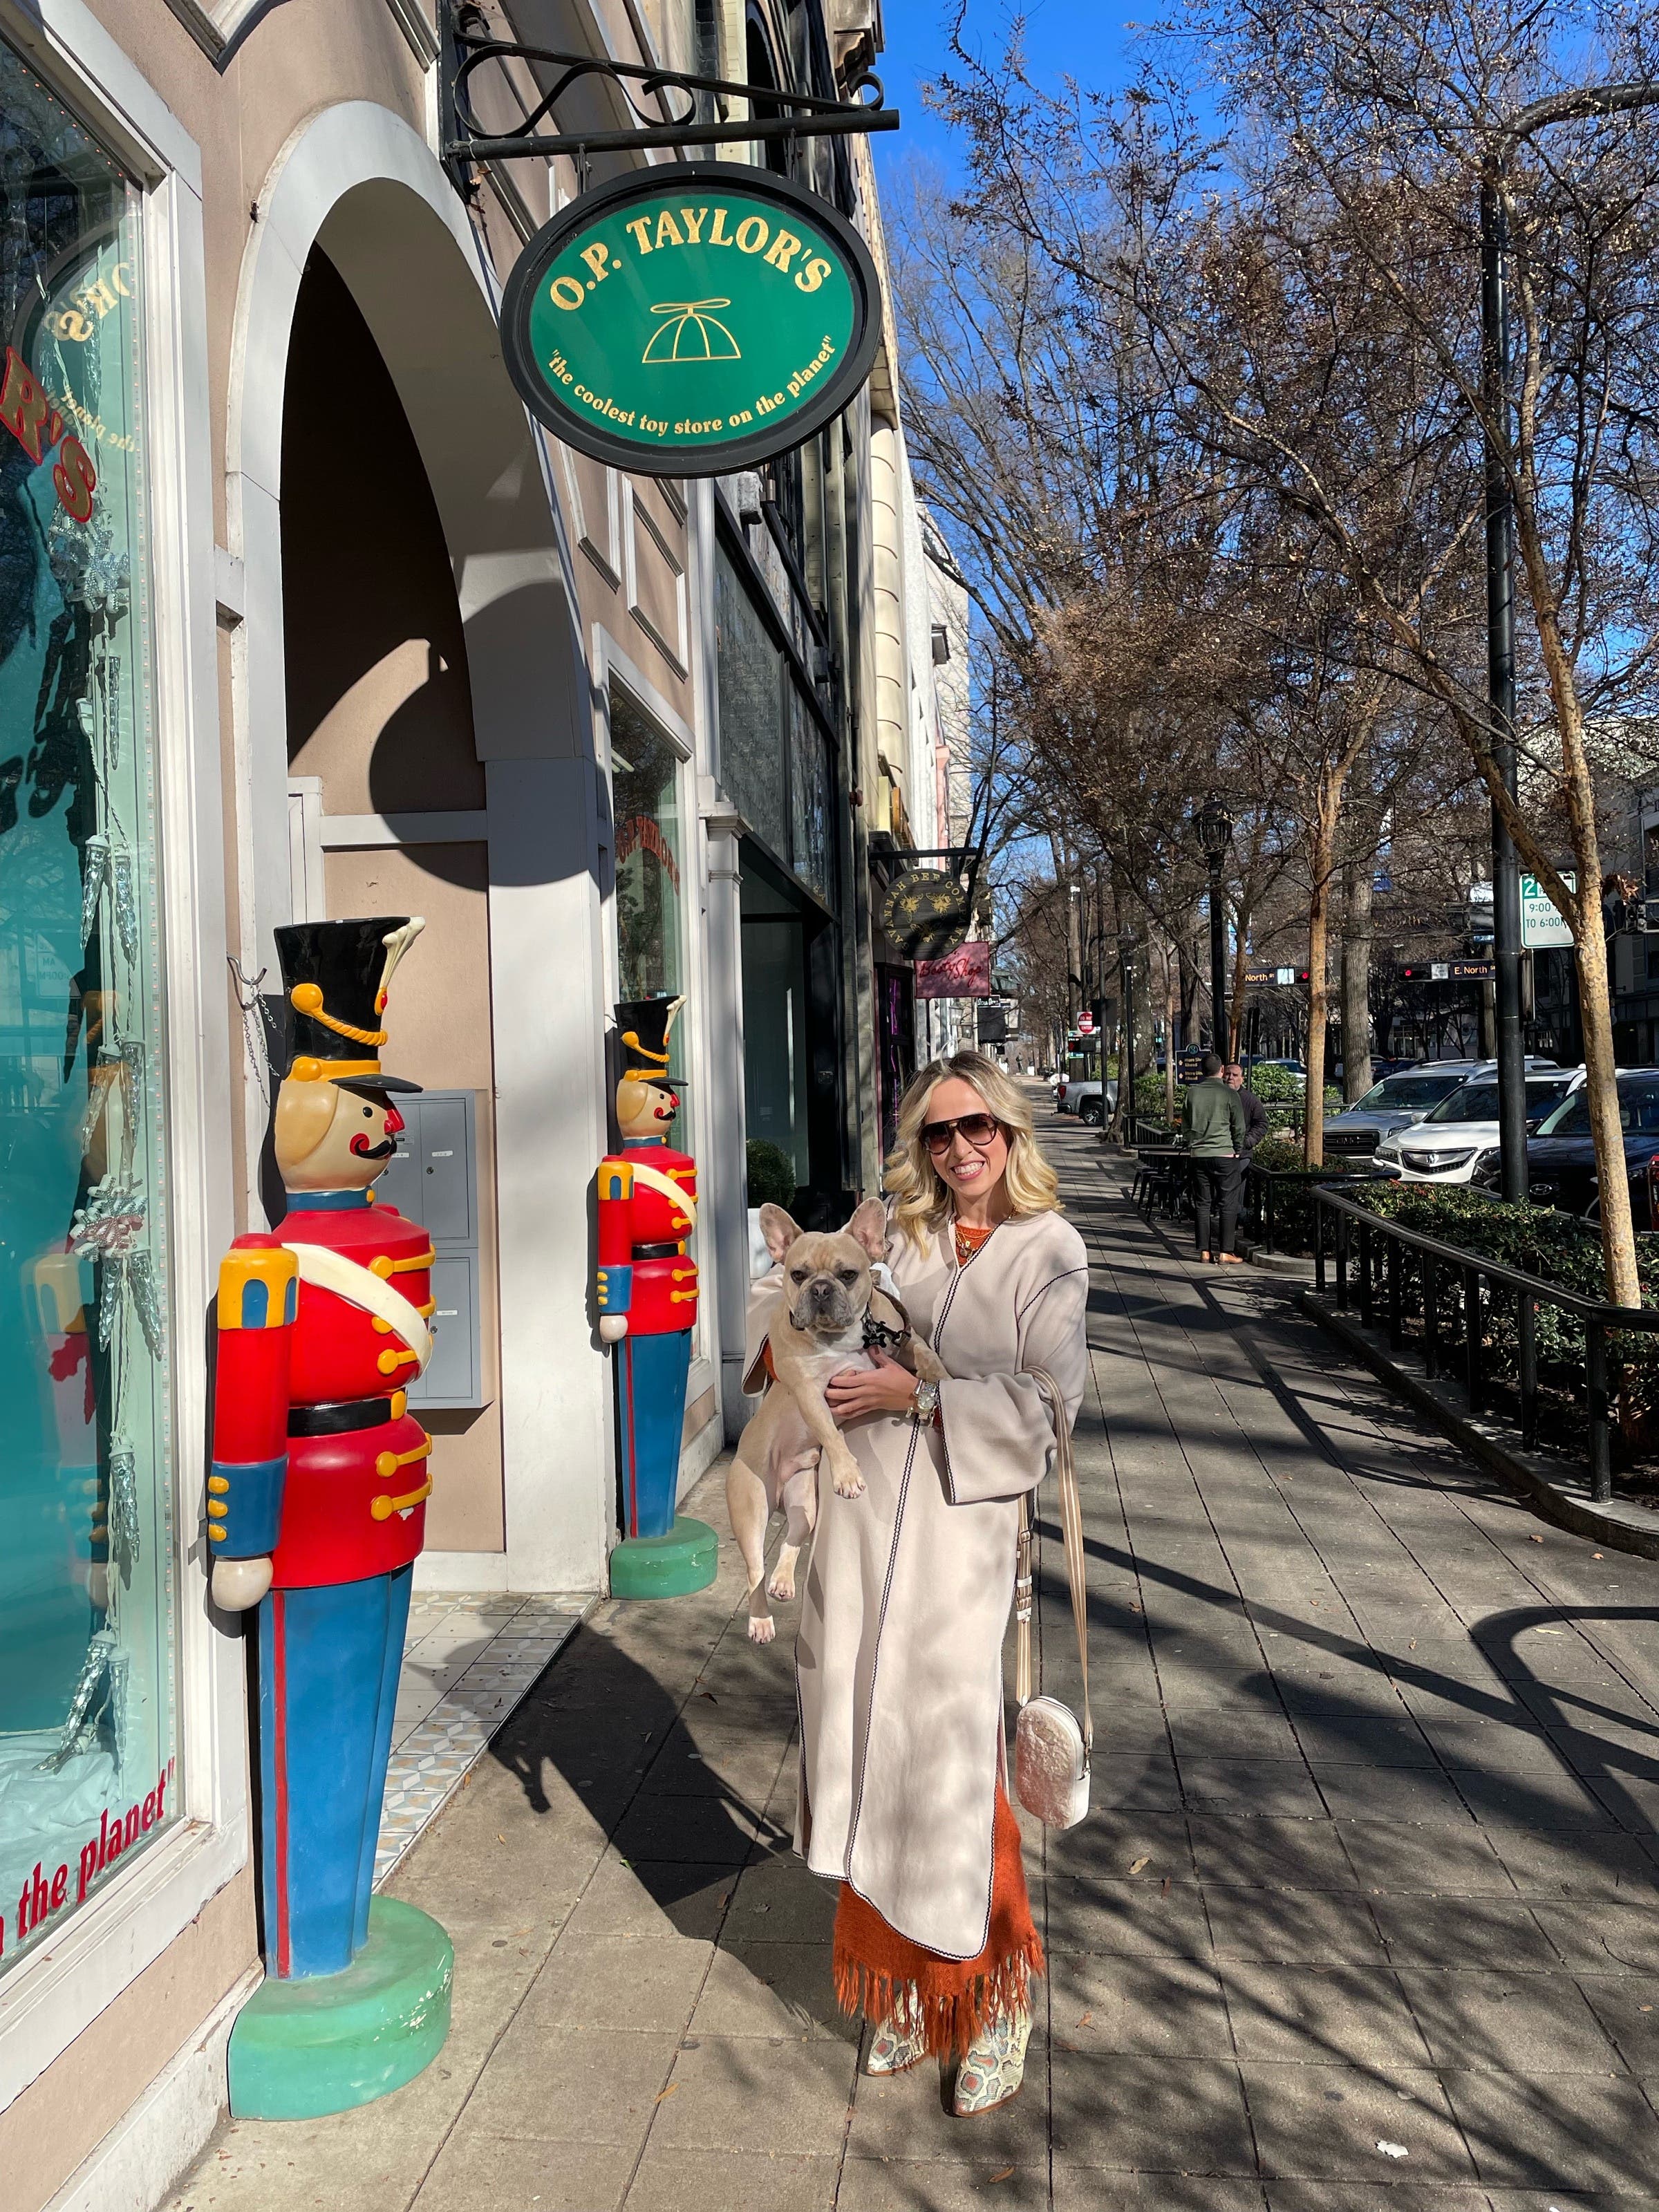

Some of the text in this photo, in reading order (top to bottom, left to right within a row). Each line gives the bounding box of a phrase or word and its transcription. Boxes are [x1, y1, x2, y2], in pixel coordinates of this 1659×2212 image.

[550, 207, 832, 310] O.P. TAYLOR'S
[549, 335, 835, 437] "the coolest toy store on the planet"
[1524, 877, 1535, 897] 2
[1529, 902, 1551, 912] 9:00
[1526, 919, 1536, 928] TO
[953, 957, 984, 988] Shop
[1245, 973, 1268, 982] North
[1454, 966, 1463, 975] E.
[1463, 965, 1488, 974] North
[18, 1756, 176, 1940] the planet"
